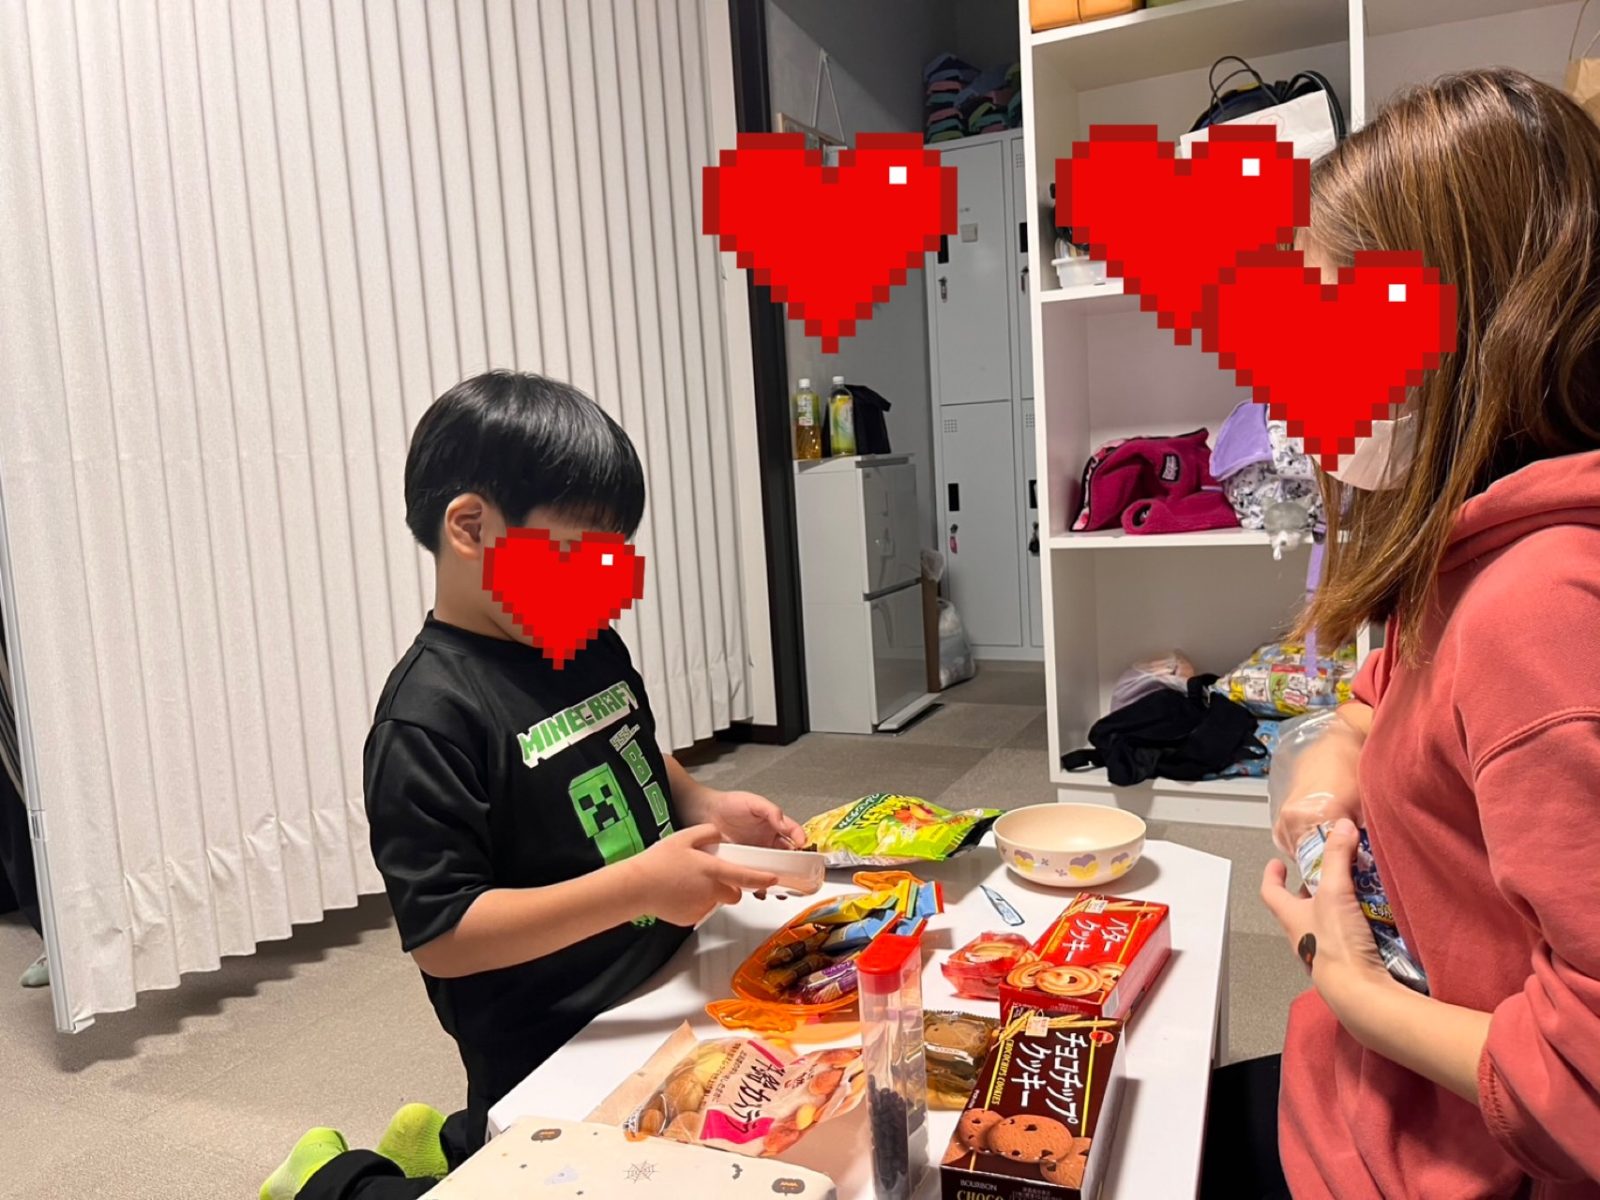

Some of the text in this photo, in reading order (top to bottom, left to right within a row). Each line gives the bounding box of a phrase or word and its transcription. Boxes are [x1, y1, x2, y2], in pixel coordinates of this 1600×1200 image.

[516, 680, 639, 769] MINECRAFT
[1062, 919, 1101, 962] クッキー
[1101, 917, 1129, 952] バター
[1011, 1042, 1052, 1107] クッキー
[1045, 1031, 1088, 1124] チョコチップ
